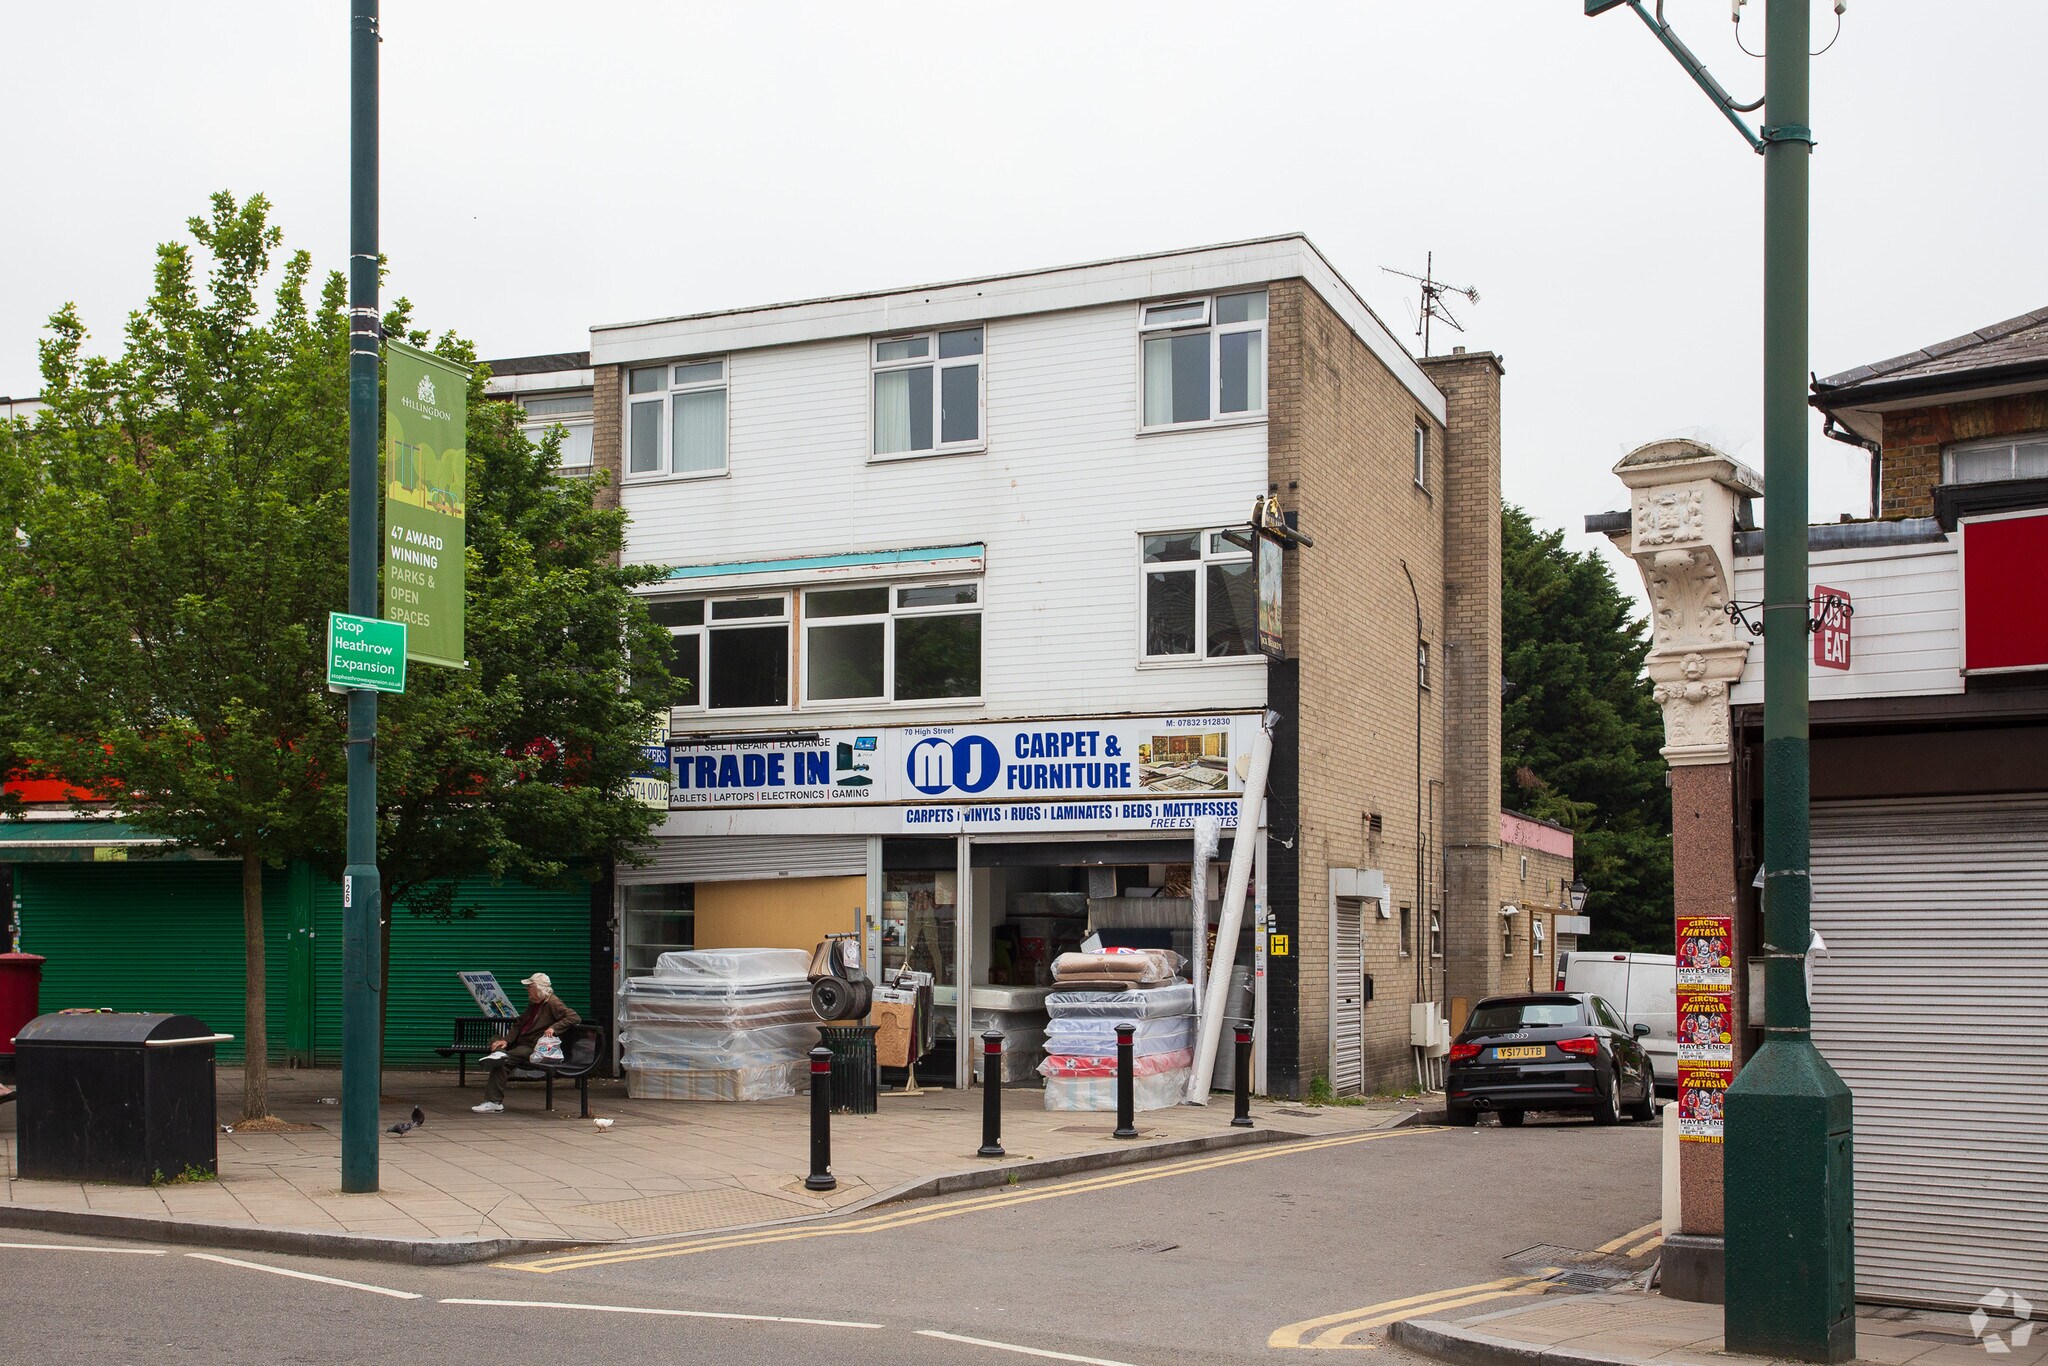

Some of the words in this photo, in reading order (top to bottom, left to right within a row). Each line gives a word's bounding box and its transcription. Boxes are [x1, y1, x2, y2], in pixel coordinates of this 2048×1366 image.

[401, 396, 450, 421] HILLINGDON
[391, 526, 404, 540] 47
[405, 529, 442, 551] AWARD
[390, 545, 438, 570] WINNING
[391, 566, 424, 586] PARKS
[428, 575, 434, 588] &
[390, 586, 418, 605] OPEN
[390, 606, 430, 627] SPACES
[1817, 593, 1848, 630] JUST
[336, 618, 364, 636] Stop
[336, 636, 392, 656] Heathrow
[1824, 630, 1848, 664] EAT
[334, 655, 394, 674] Expansion
[332, 674, 402, 687] stopheathrowexpansion.co.uk
[914, 728, 931, 737] High
[674, 742, 692, 752] BUY
[704, 742, 726, 751] SELL
[736, 740, 768, 750] REPAIR
[779, 738, 830, 748] EXCHANGE
[1015, 731, 1100, 760] CARPET
[1105, 734, 1122, 756] &
[674, 752, 785, 789] TRADE
[794, 751, 830, 786] IN
[1007, 762, 1132, 790] FURNITURE
[648, 783, 668, 800] 0012
[670, 793, 707, 802] TABLETS
[714, 792, 754, 801] LAPTOPS
[761, 790, 824, 800] ELECTRONICS
[832, 788, 869, 798] GAMING
[906, 808, 954, 823] CARPETS
[963, 807, 1001, 822] VINYLS
[1011, 806, 1041, 821] RUGS
[1051, 804, 1112, 820] LAMINATES
[1123, 804, 1152, 818] BEDS
[1163, 802, 1238, 817] MATTRESSES
[1151, 817, 1176, 828] FREE
[1680, 926, 1728, 936] FANTASIA
[1274, 937, 1285, 952] H
[1680, 1003, 1727, 1012] FANTASIA
[1501, 1048, 1521, 1056] YS17
[1523, 1047, 1542, 1056] UTB
[1682, 1078, 1728, 1088] FANTASIA
